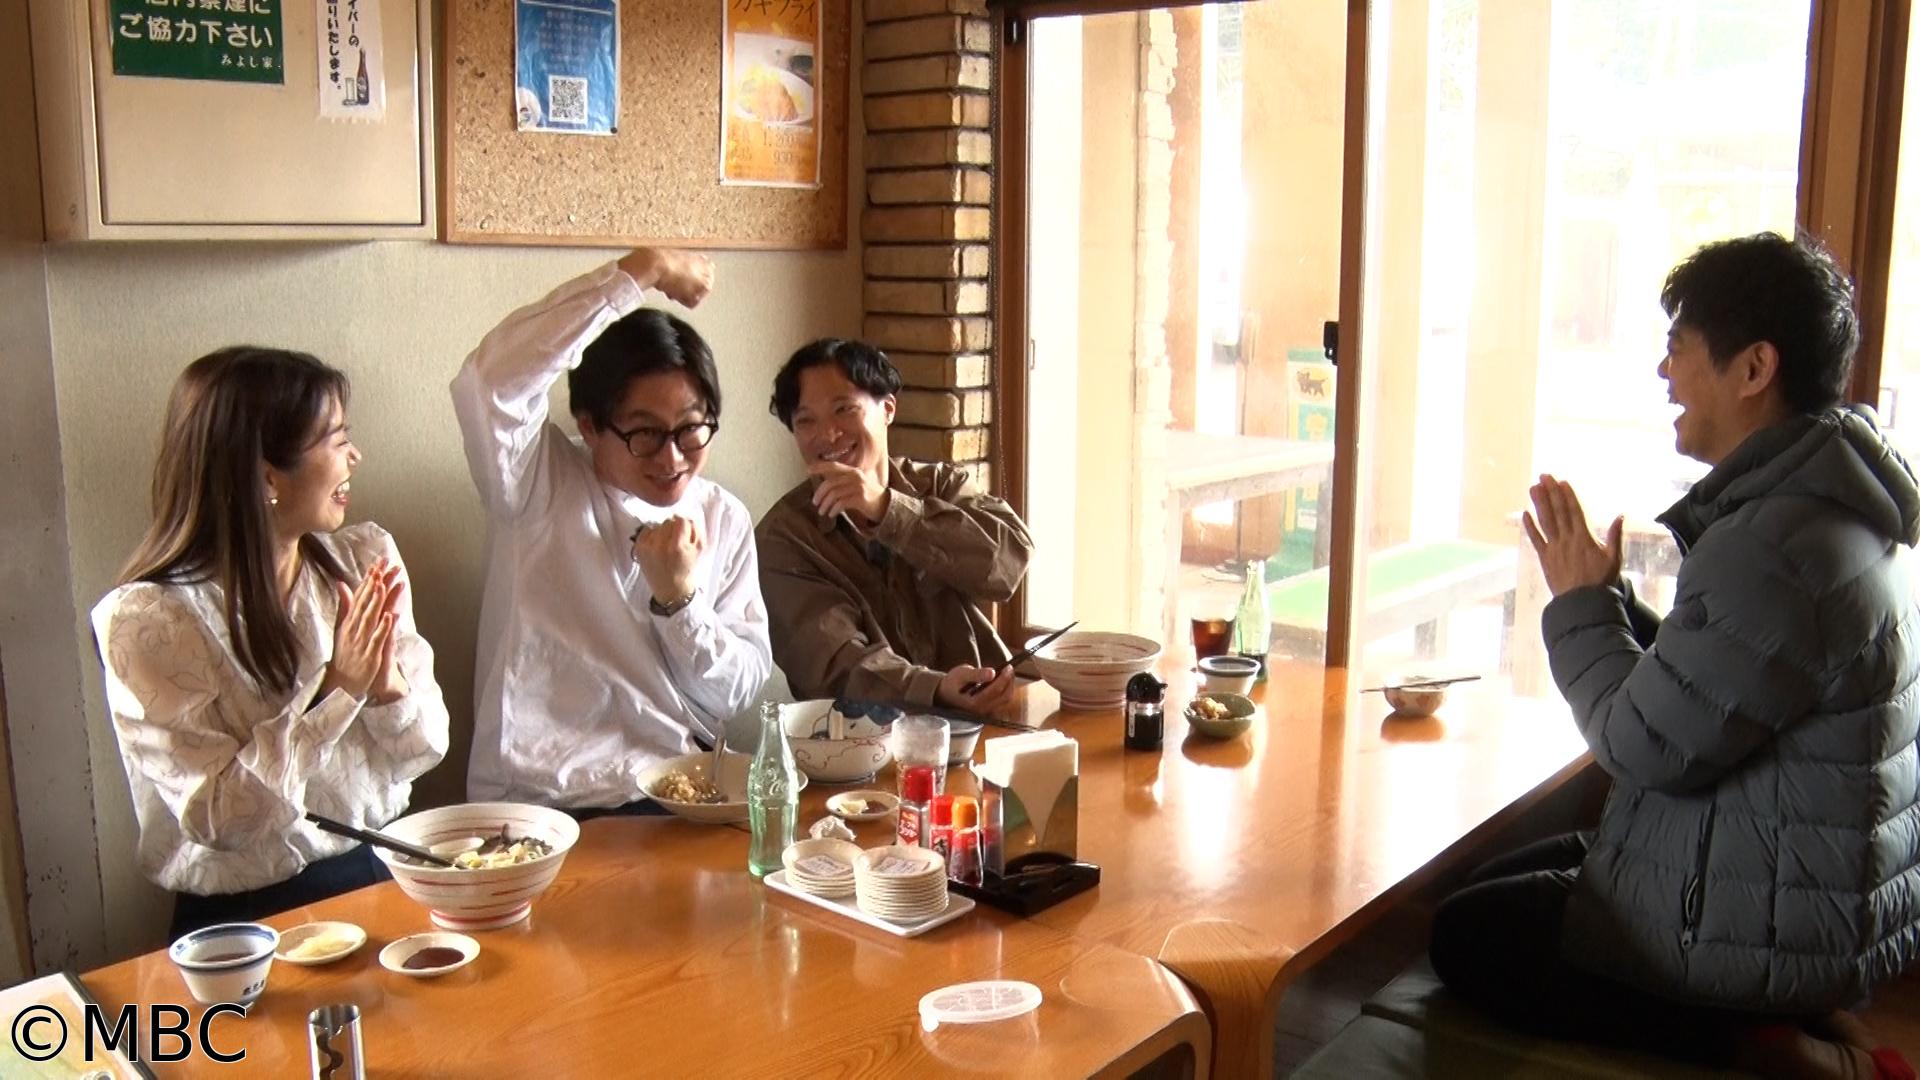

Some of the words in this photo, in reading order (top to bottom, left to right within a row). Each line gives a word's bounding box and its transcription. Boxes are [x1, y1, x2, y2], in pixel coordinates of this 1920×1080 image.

[119, 13, 274, 48] ご協力下さい
[220, 53, 273, 69] みよし家
